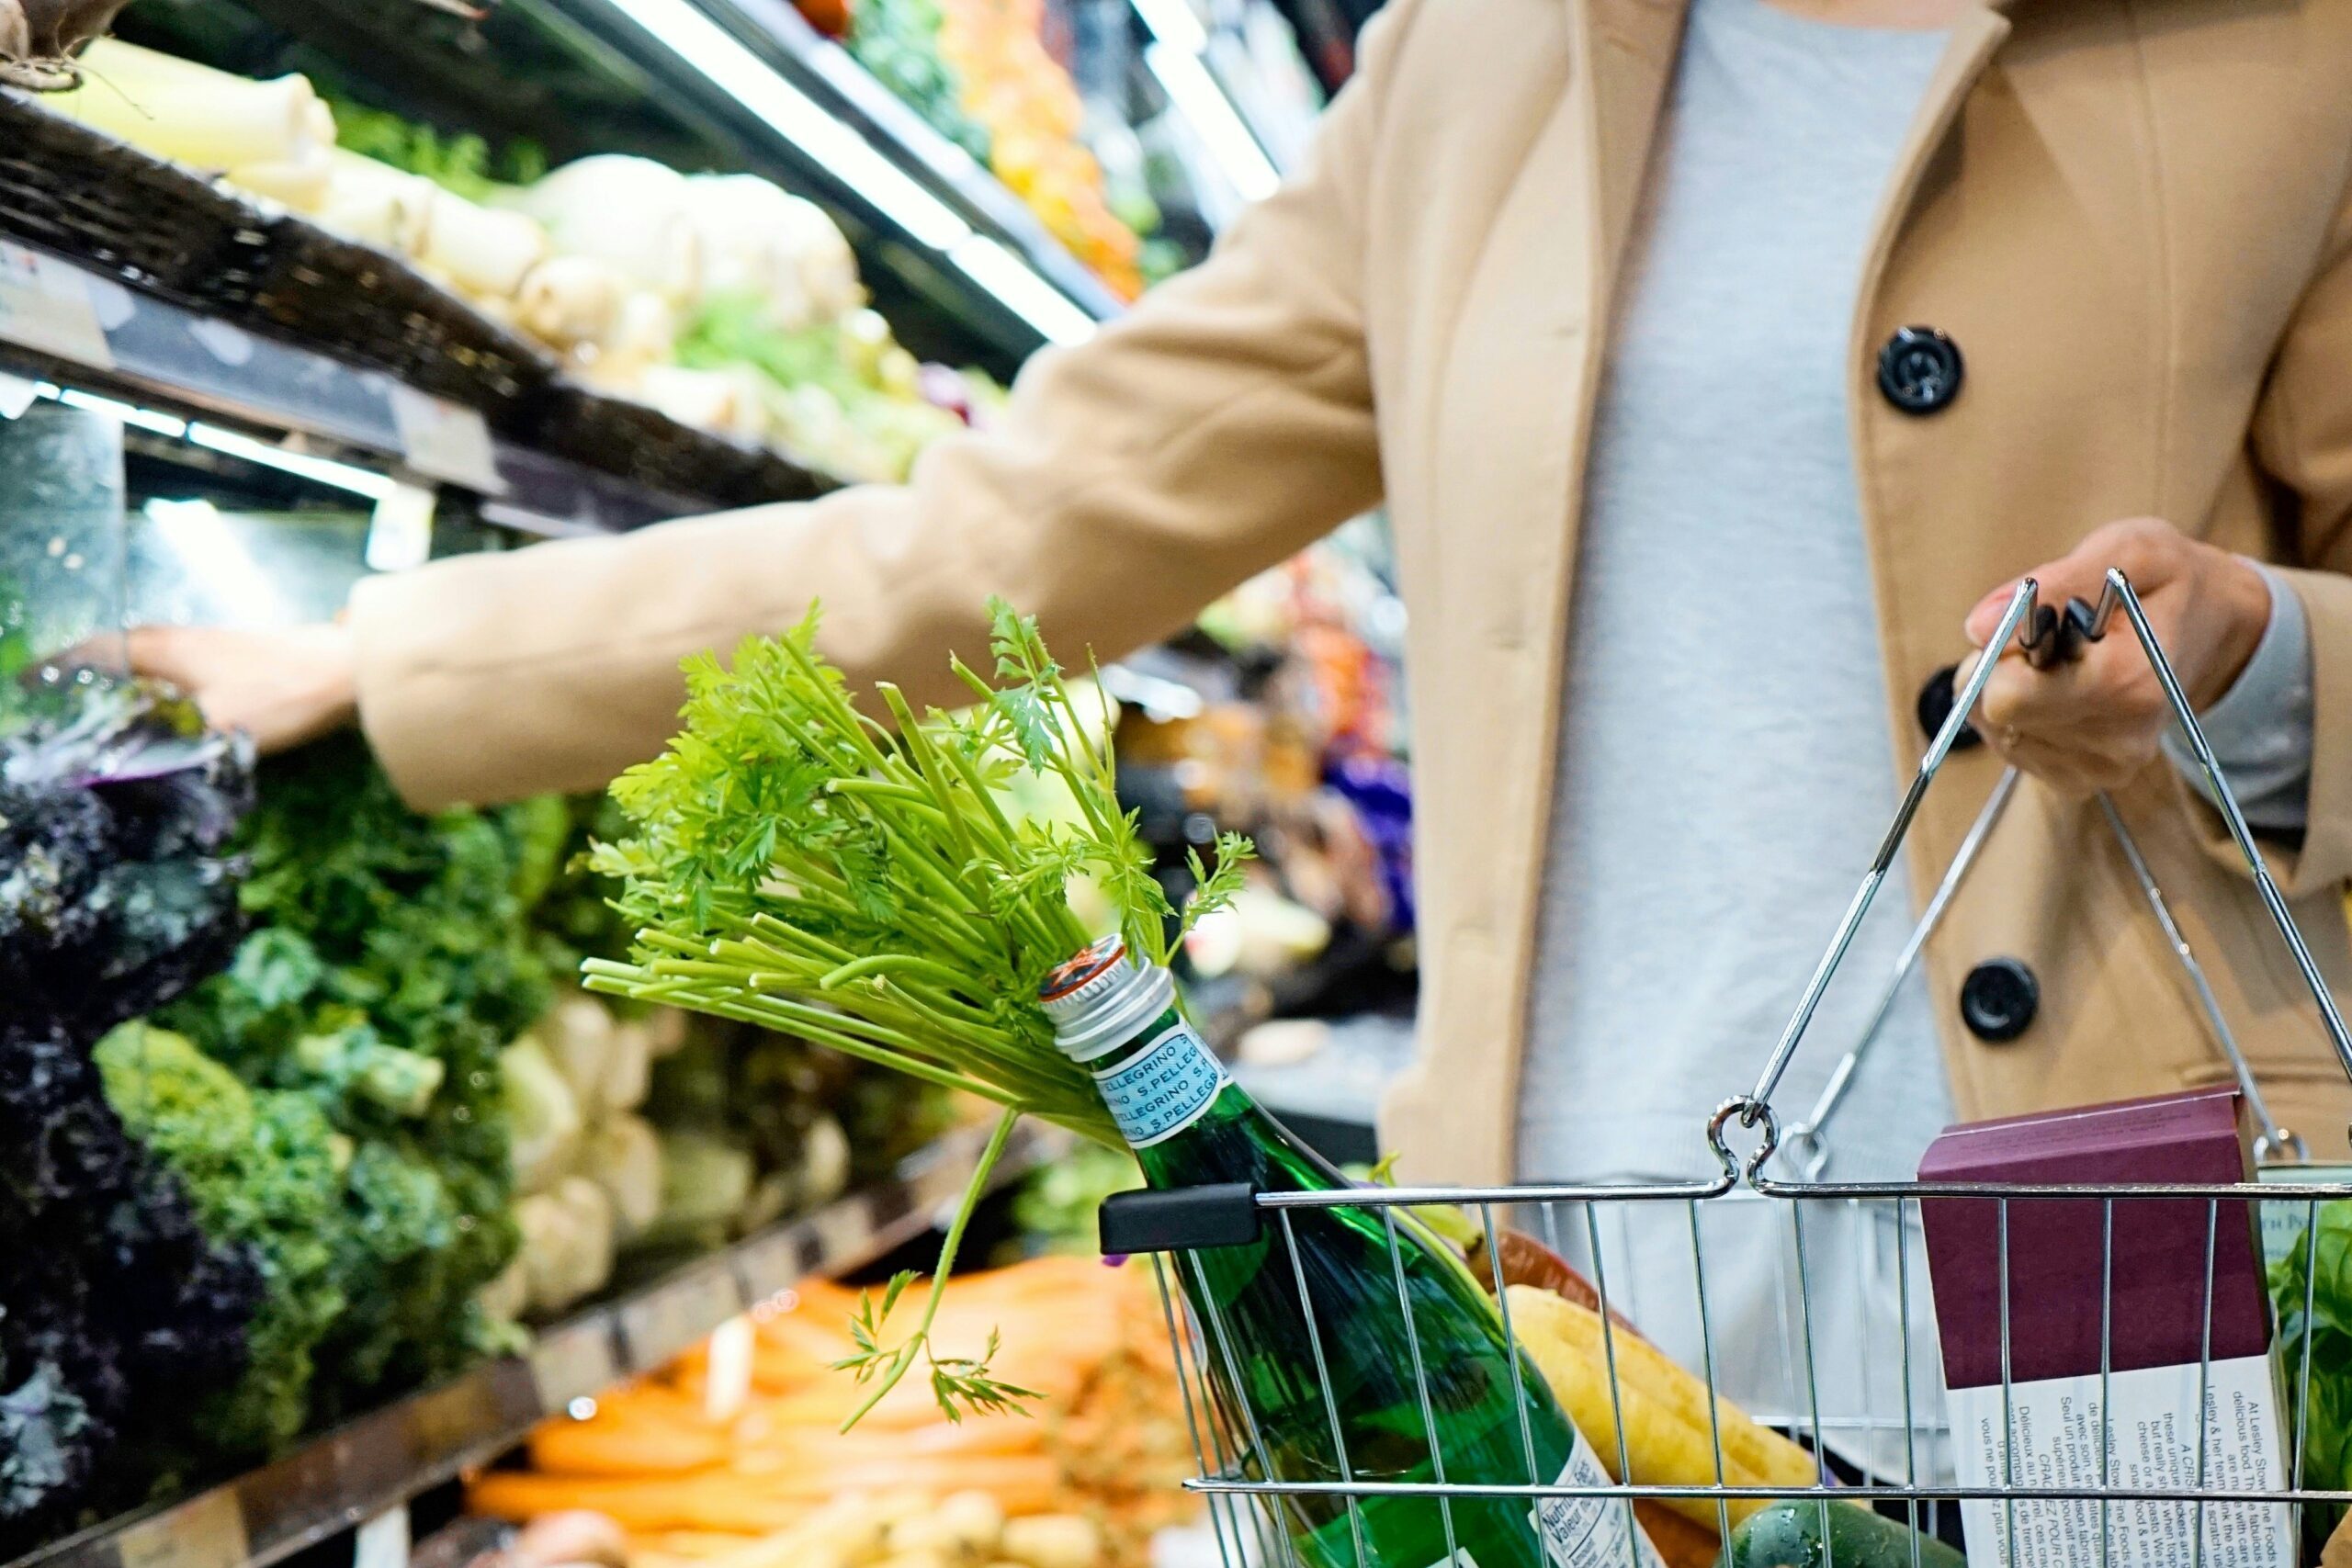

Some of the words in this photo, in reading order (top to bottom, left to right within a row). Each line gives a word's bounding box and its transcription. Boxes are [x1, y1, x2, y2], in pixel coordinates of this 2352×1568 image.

[1104, 1045, 1177, 1092] ELLEGRINO
[2061, 1396, 2075, 1422] Seul
[2088, 1403, 2098, 1416] de
[2248, 1402, 2259, 1414] At
[1981, 1418, 1992, 1445] vous
[2064, 1426, 2075, 1440] un
[2076, 1414, 2087, 1440] avec
[2151, 1420, 2162, 1438] but
[2163, 1413, 2175, 1444] these
[2211, 1427, 2222, 1435] &
[2249, 1417, 2263, 1454] Lesley
[2137, 1421, 2151, 1462] cheese
[2180, 1444, 2192, 1452] A
[2212, 1438, 2222, 1457] her
[1985, 1449, 1995, 1462] ne
[2065, 1443, 2081, 1483] produit
[2080, 1444, 2092, 1470] soin,
[2154, 1442, 2166, 1472] really
[2168, 1448, 2180, 1486] unique
[2228, 1454, 2238, 1472] are
[2018, 1406, 2034, 1458] Délicieux
[2027, 1461, 2037, 1475] au
[2035, 1525, 2044, 1544] ces
[2143, 1466, 2152, 1478] or
[2182, 1457, 2197, 1486] CRIS
[2215, 1461, 2226, 1490] team
[2233, 1391, 2247, 1441] delicious
[2240, 1445, 2252, 1472] food.
[2249, 1515, 2263, 1562] fabulous
[1992, 1512, 2005, 1535] plus
[2020, 1510, 2030, 1524] de
[2059, 1500, 2076, 1540] pouvait
[2087, 1499, 2099, 1529] etites
[2109, 1460, 2120, 1487] Stow
[2119, 1527, 2131, 1562] Foods
[2235, 1512, 2247, 1535] with
[1550, 1508, 1583, 1544] Valeur
[2048, 1519, 2063, 1555] POUR
[2163, 1509, 2174, 1540] when
[2208, 1510, 2222, 1551] scratch
[2223, 1525, 2233, 1542] the
[1997, 1539, 2008, 1565] vous
[2022, 1529, 2035, 1568] trempe
[2139, 1540, 2150, 1559] are
[2153, 1538, 2164, 1557] We
[2165, 1543, 2178, 1568] topp
[2180, 1541, 2190, 1559] are
[2238, 1538, 2249, 1562] care
[2265, 1527, 2277, 1562] Foods
